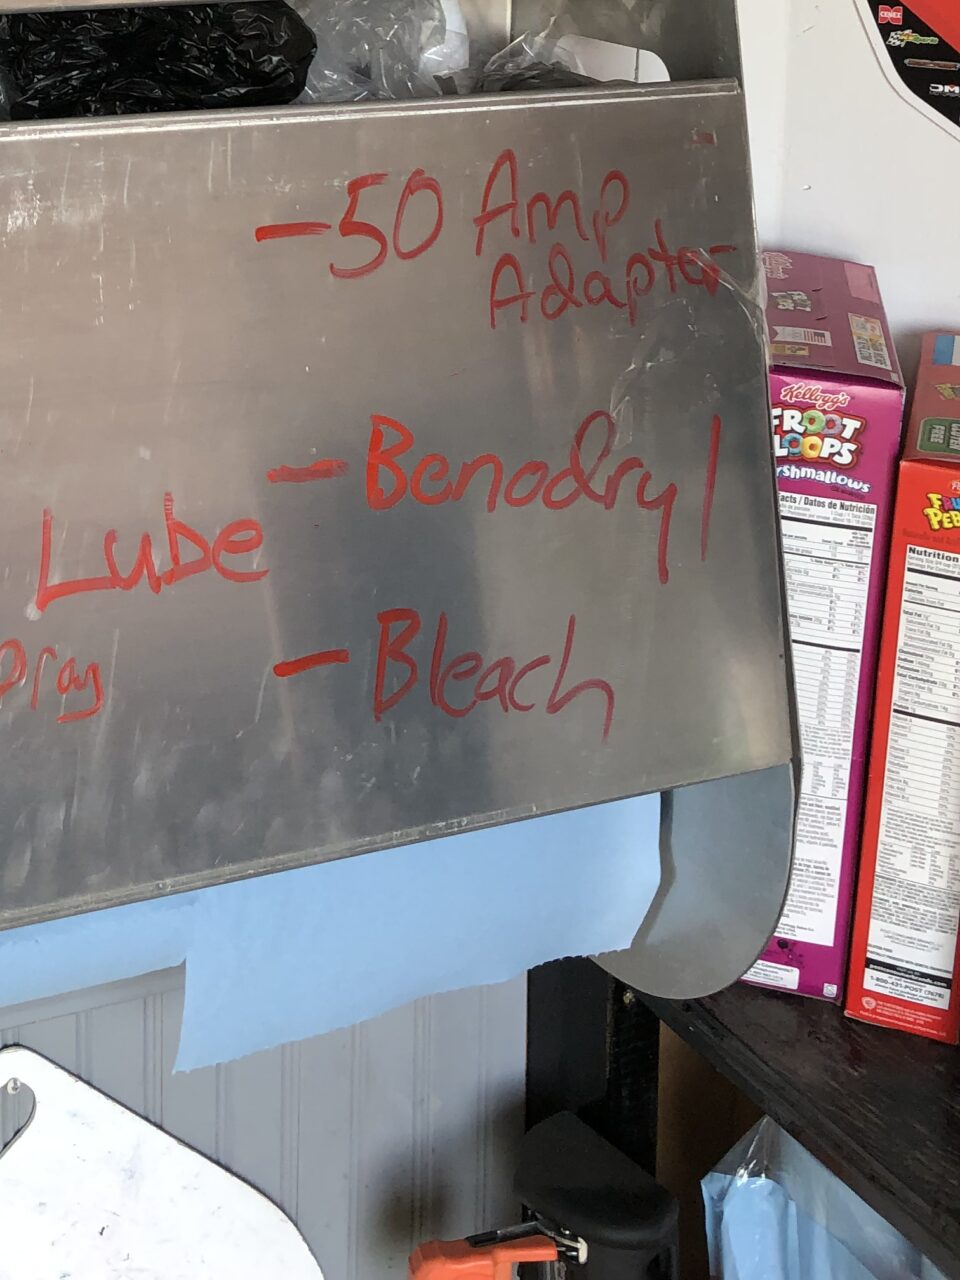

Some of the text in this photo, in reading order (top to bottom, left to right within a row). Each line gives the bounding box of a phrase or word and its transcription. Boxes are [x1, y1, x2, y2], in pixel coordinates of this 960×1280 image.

[474, 149, 630, 262] Amp
[780, 383, 852, 411] Kellogg's
[772, 407, 862, 440] FROOT
[930, 424, 946, 445] FREE
[773, 433, 857, 465] LOOPS
[366, 410, 722, 585] Benodryl
[778, 492, 797, 505] acts
[804, 496, 826, 508] Datos
[828, 501, 837, 510] de
[839, 502, 876, 515] Nutrición
[34, 490, 270, 613] Lube
[908, 546, 959, 563] Nutrition
[376, 607, 615, 744] Bleach
